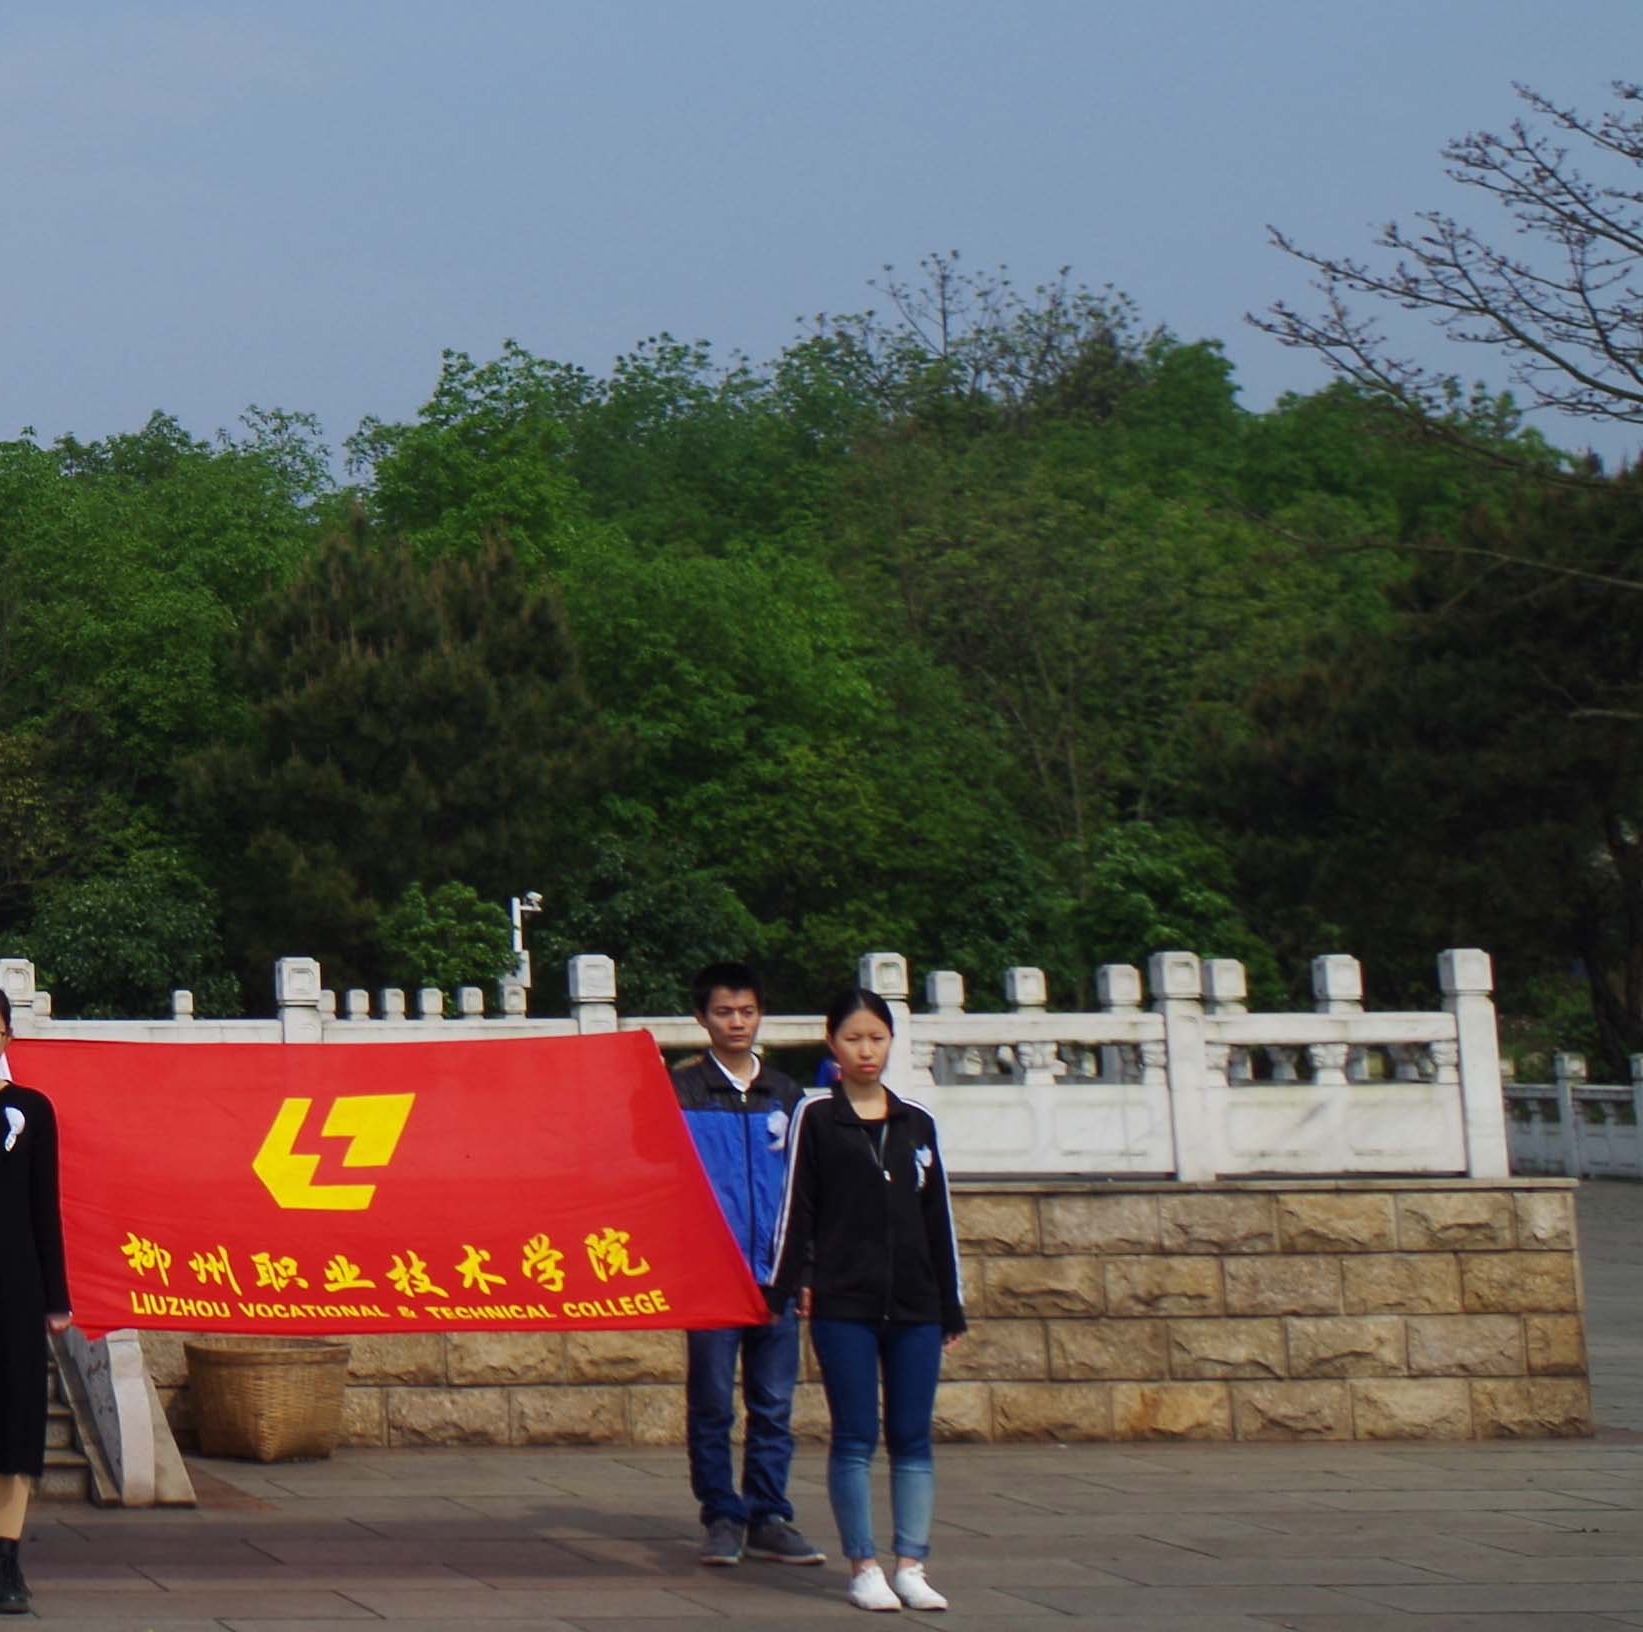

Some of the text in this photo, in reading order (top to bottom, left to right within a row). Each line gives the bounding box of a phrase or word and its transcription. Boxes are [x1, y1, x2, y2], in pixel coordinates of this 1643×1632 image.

[120, 1227, 651, 1298] 柳州职业技术学院
[130, 1289, 671, 1320] LIUZHOU VOCATIONAL & TECHNICAL COLLEGE
